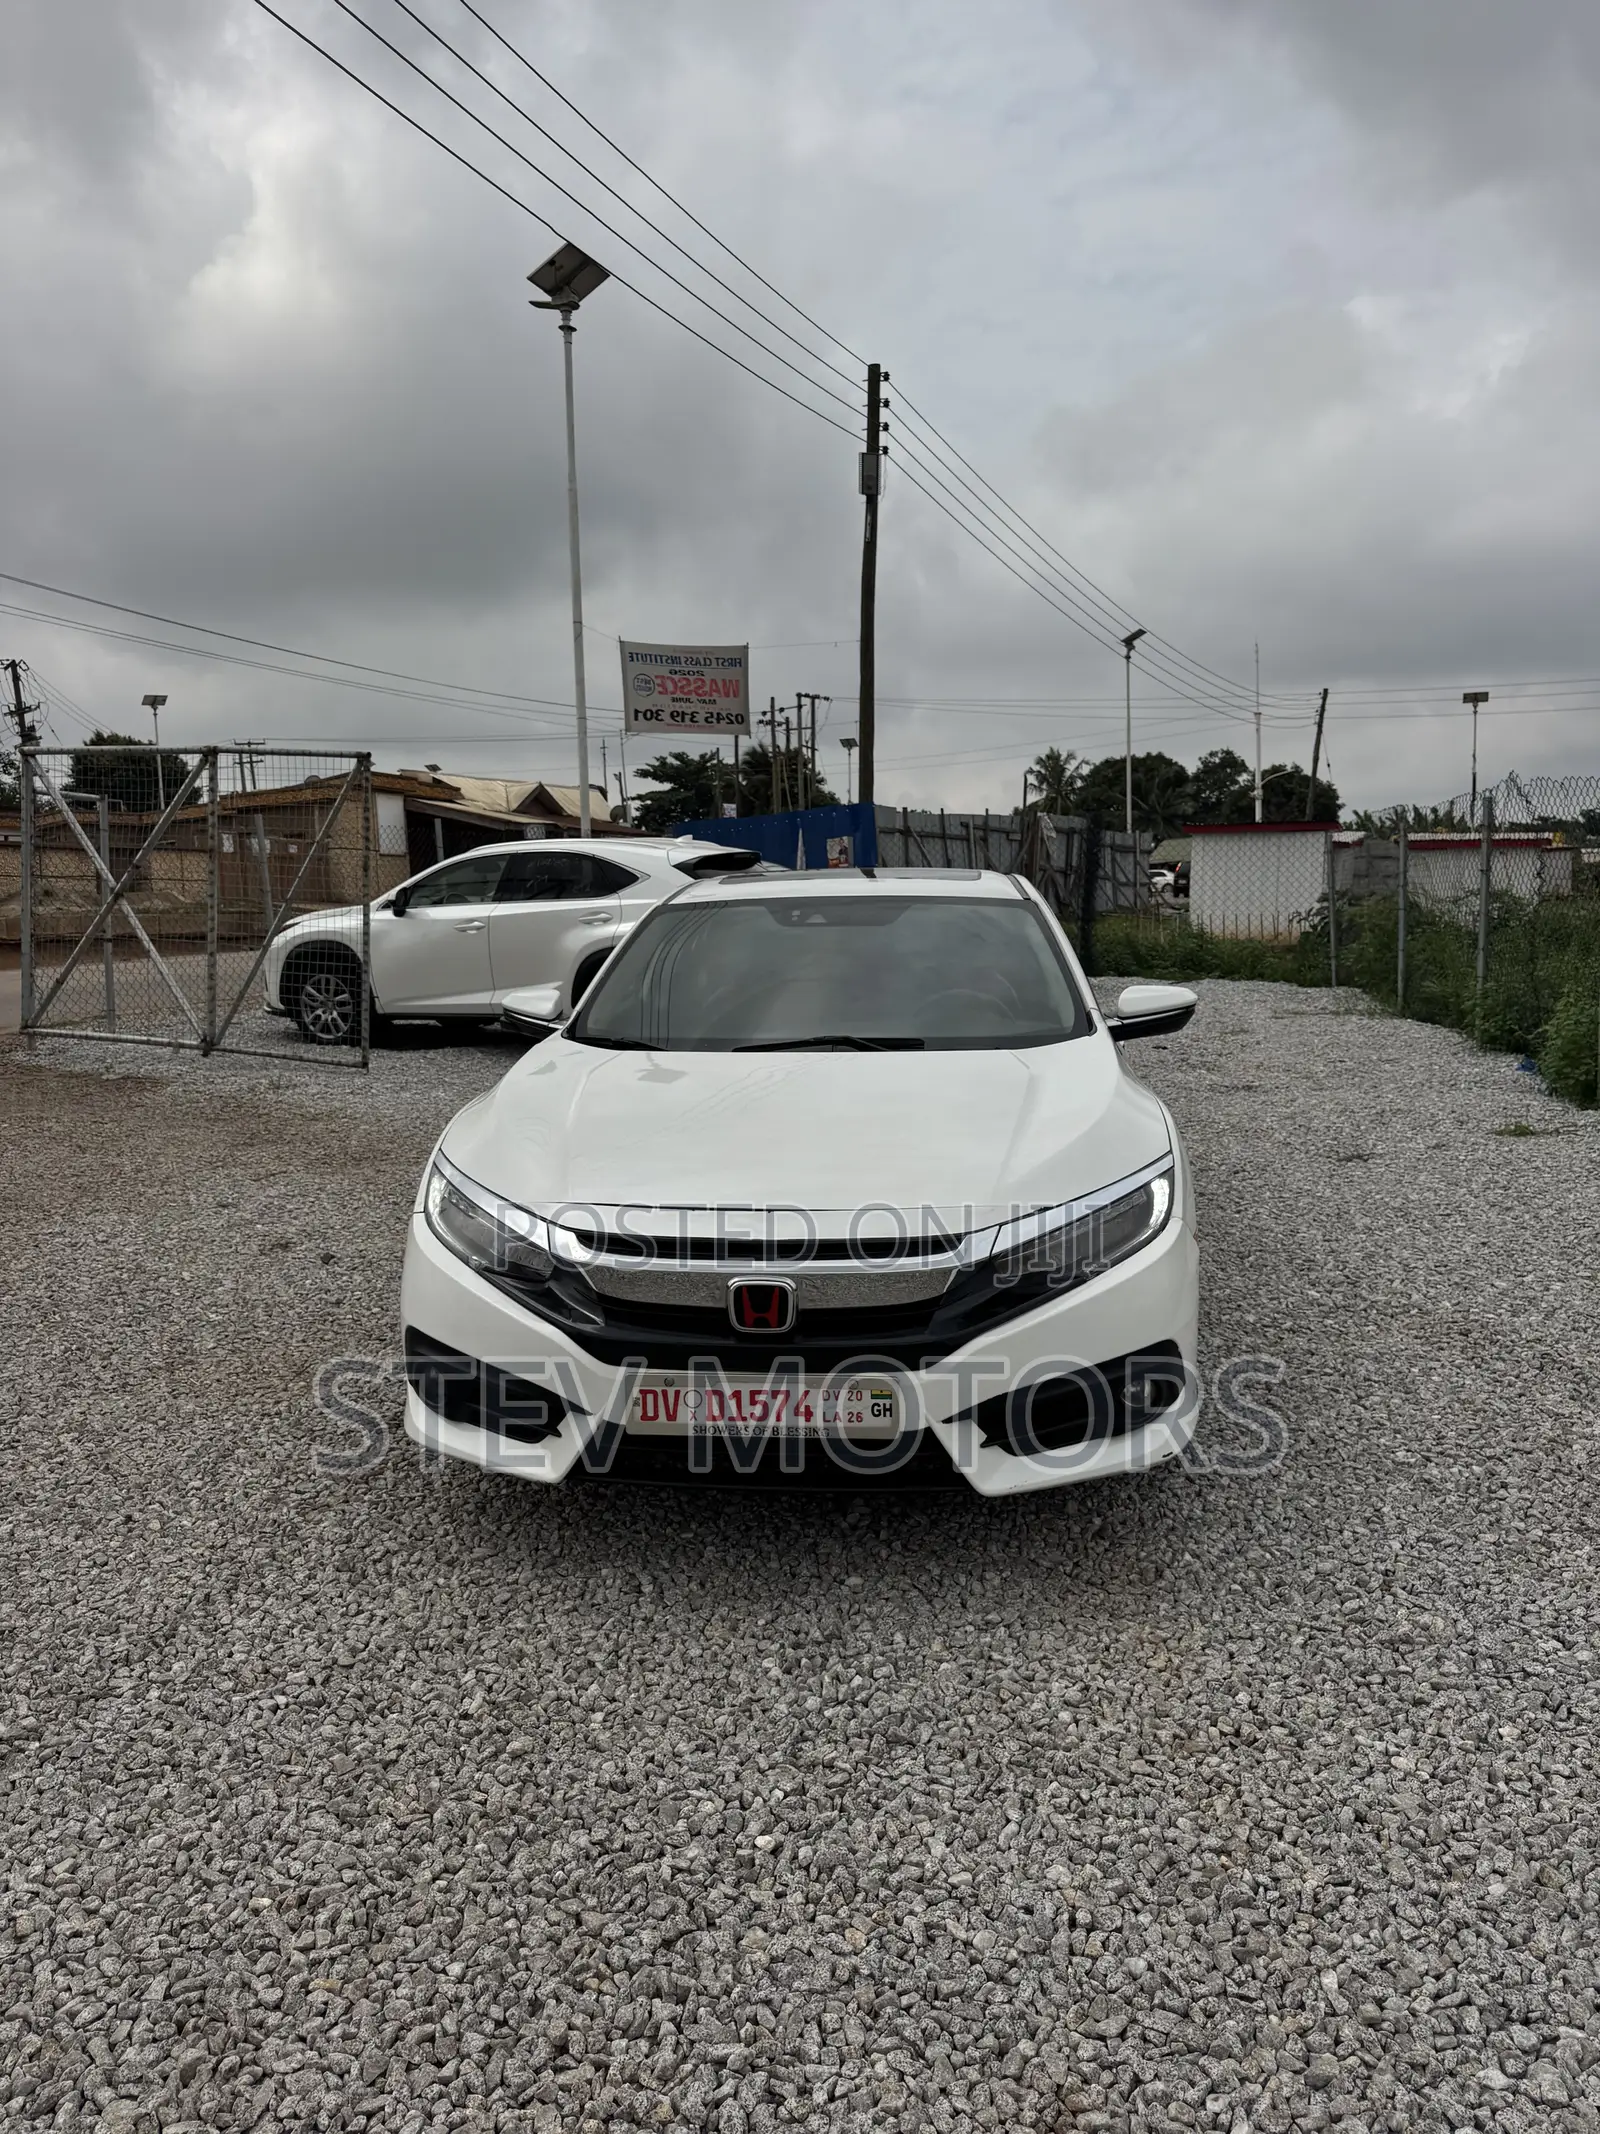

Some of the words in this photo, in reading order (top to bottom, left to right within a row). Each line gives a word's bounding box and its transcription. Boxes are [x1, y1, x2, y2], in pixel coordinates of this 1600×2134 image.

[822, 1389, 841, 1402] DV
[847, 1389, 863, 1402] 20
[638, 1388, 681, 1422] DV
[705, 1388, 813, 1423] D1574
[871, 1402, 893, 1418] GH
[822, 1411, 842, 1424] LA
[847, 1411, 864, 1423] 26
[692, 1425, 750, 1437] SHOWERS
[752, 1426, 769, 1437] OF
[772, 1426, 831, 1438] BLESSING
